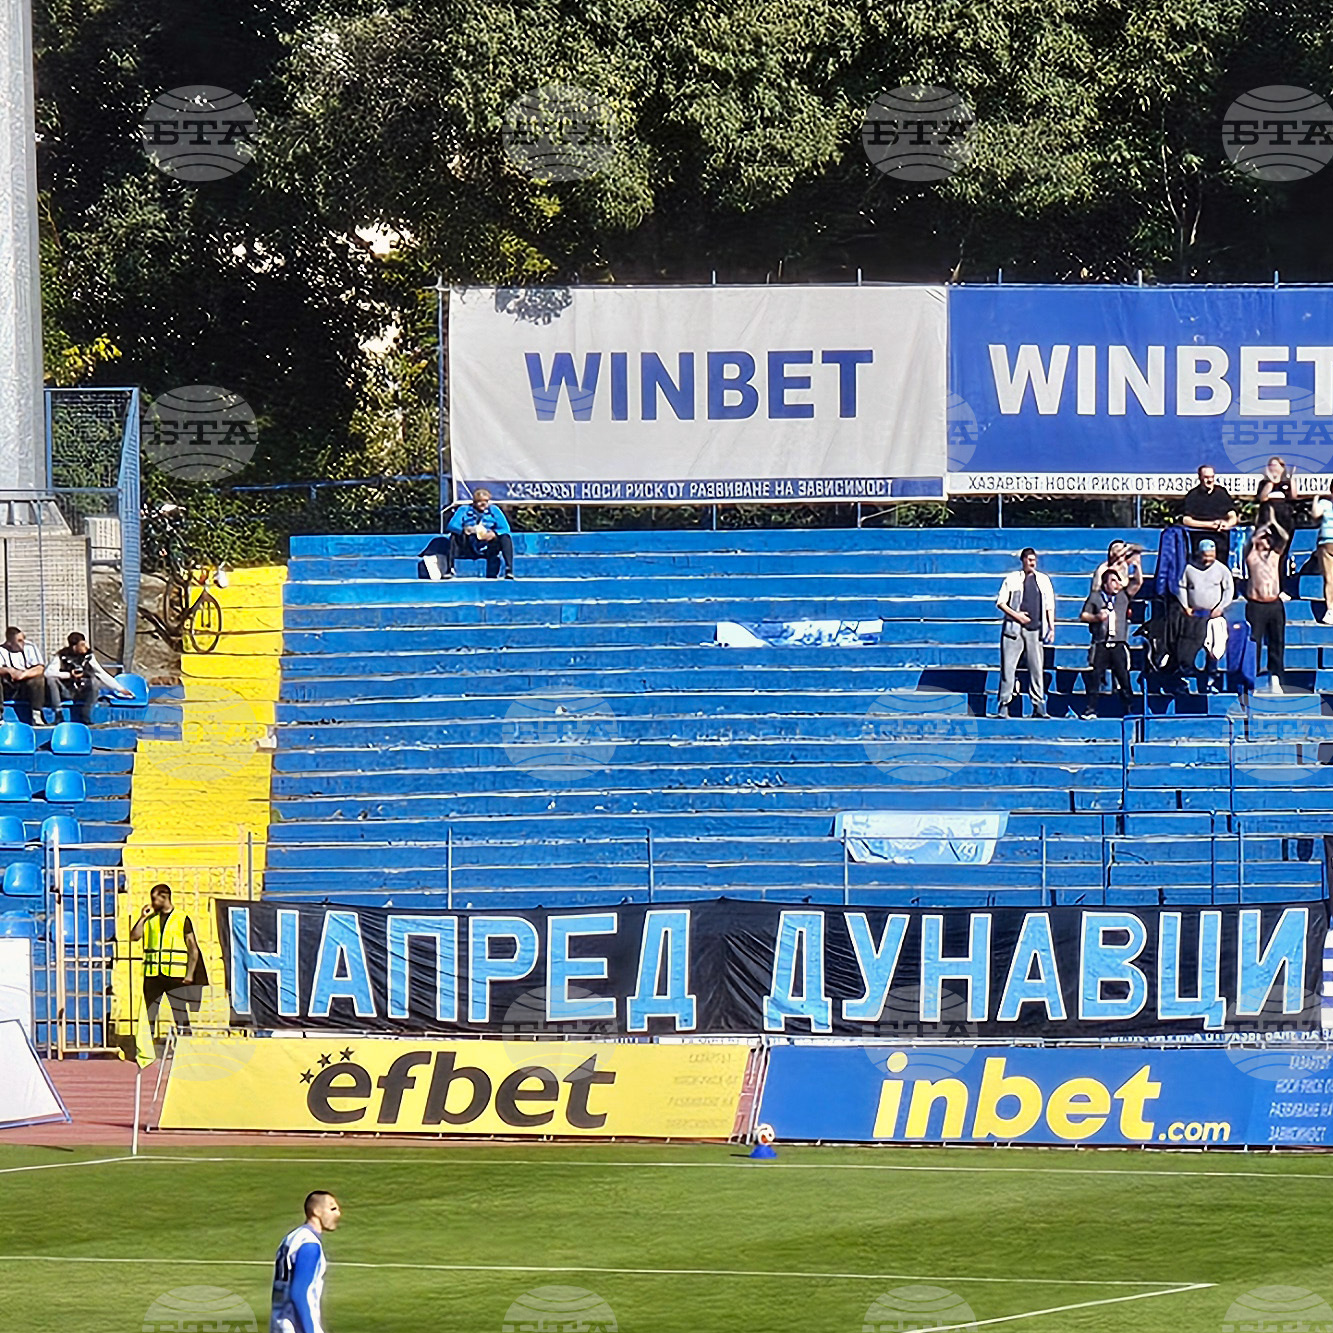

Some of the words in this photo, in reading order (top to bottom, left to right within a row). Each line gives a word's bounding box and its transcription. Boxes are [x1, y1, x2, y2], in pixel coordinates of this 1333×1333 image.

[525, 349, 875, 423] WINBET
[581, 482, 621, 500] НОСИ
[625, 482, 664, 499] РИСК
[667, 482, 686, 498] ОТ
[689, 481, 770, 498] РАЗВИВАНЕ
[774, 481, 794, 497] НА
[798, 479, 893, 497] ЗАВИСИМОСТ
[968, 476, 1040, 491] ХАЗАРТЪТ
[1045, 476, 1087, 491] НОСИ
[1091, 476, 1131, 491] РИСК
[1135, 476, 1152, 491] ОТ
[226, 906, 698, 1033] НАПРЕД
[762, 907, 1309, 1033] ДУНАВЦИ
[306, 1050, 617, 1129] efbet
